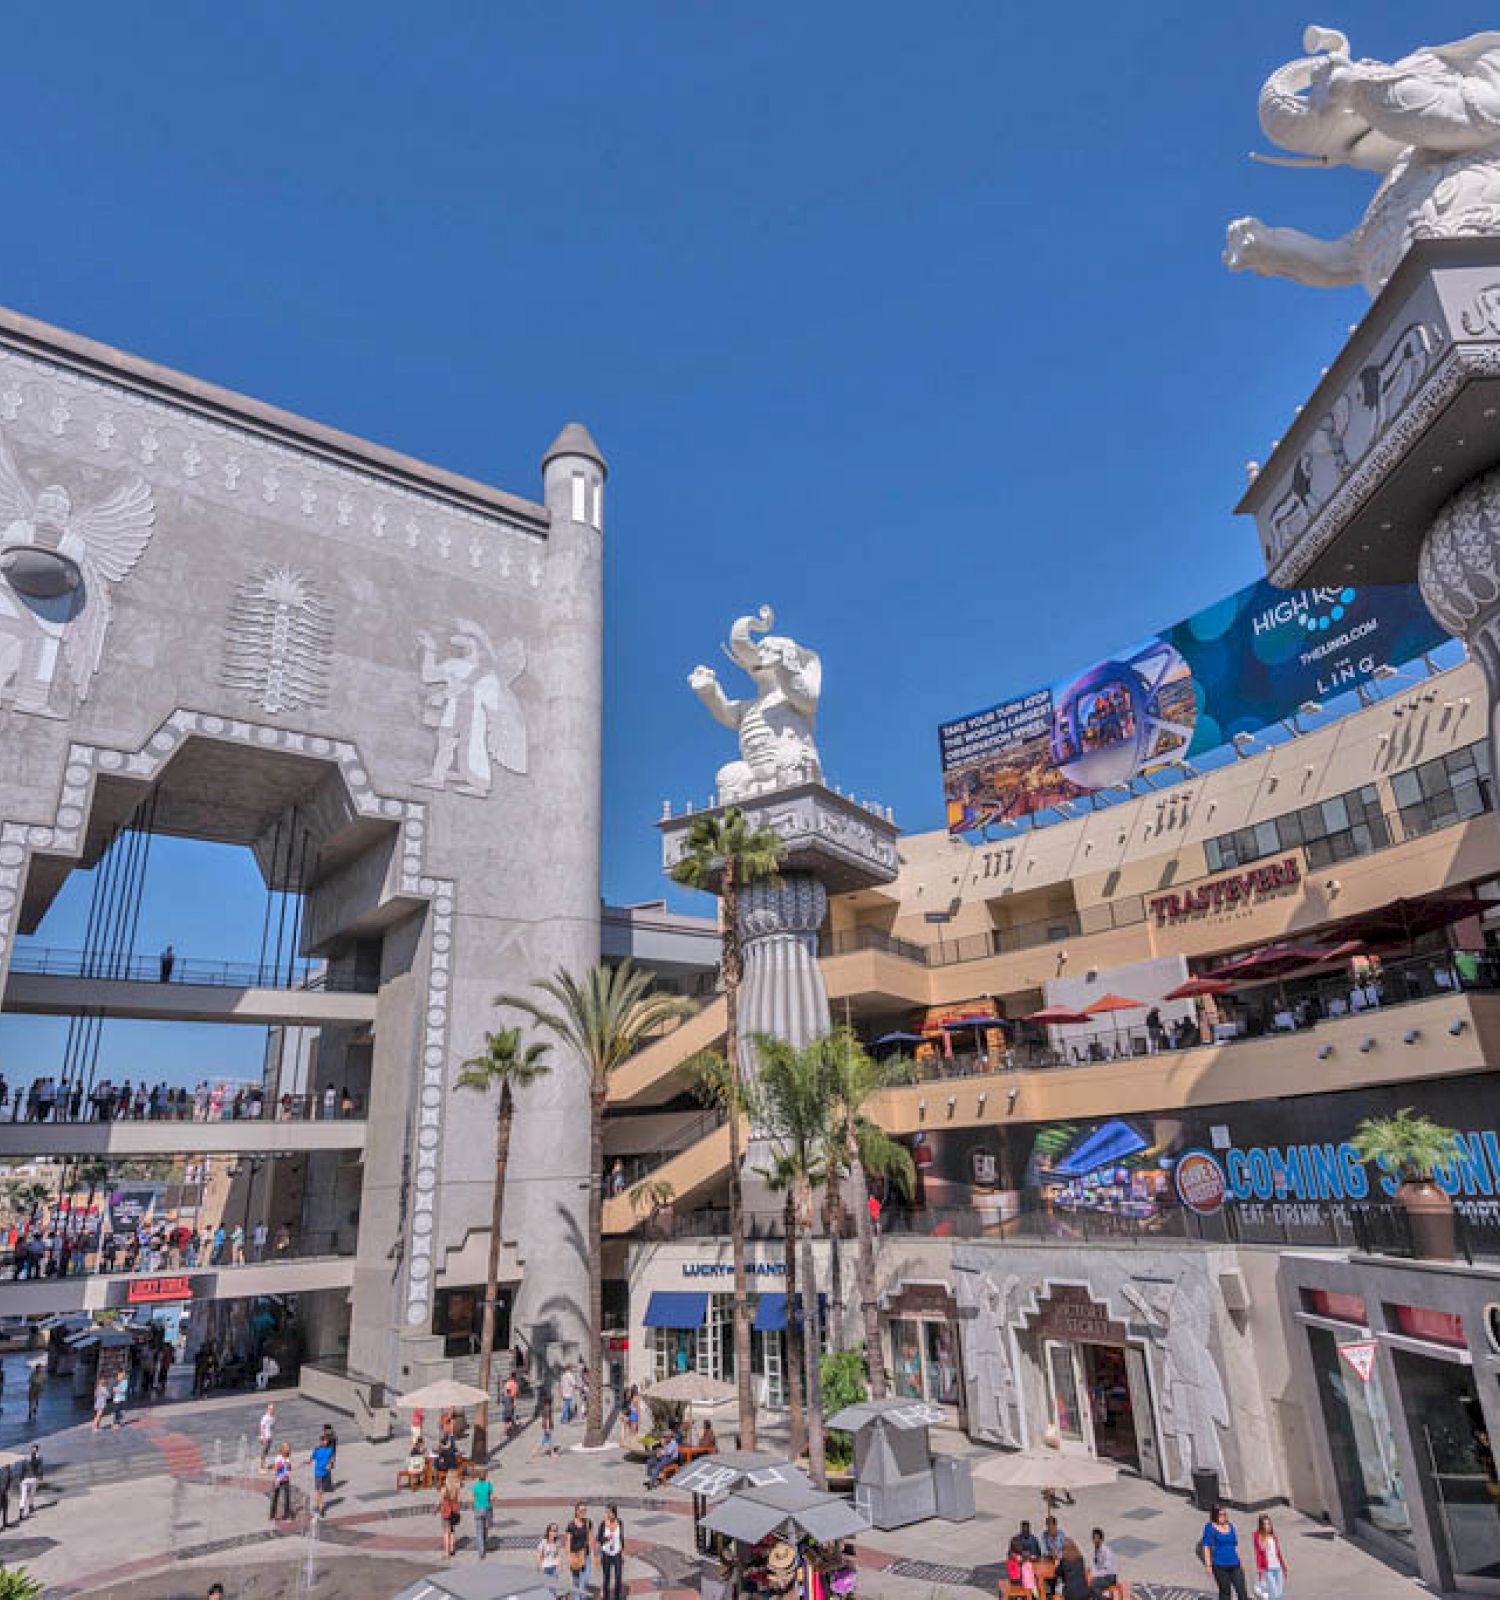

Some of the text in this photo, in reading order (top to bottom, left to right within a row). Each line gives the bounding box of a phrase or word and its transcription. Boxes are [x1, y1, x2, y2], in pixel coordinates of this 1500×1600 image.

[1252, 590, 1308, 635] HIGH
[1316, 653, 1375, 694] LINQ
[1226, 1142, 1368, 1200] COMING
